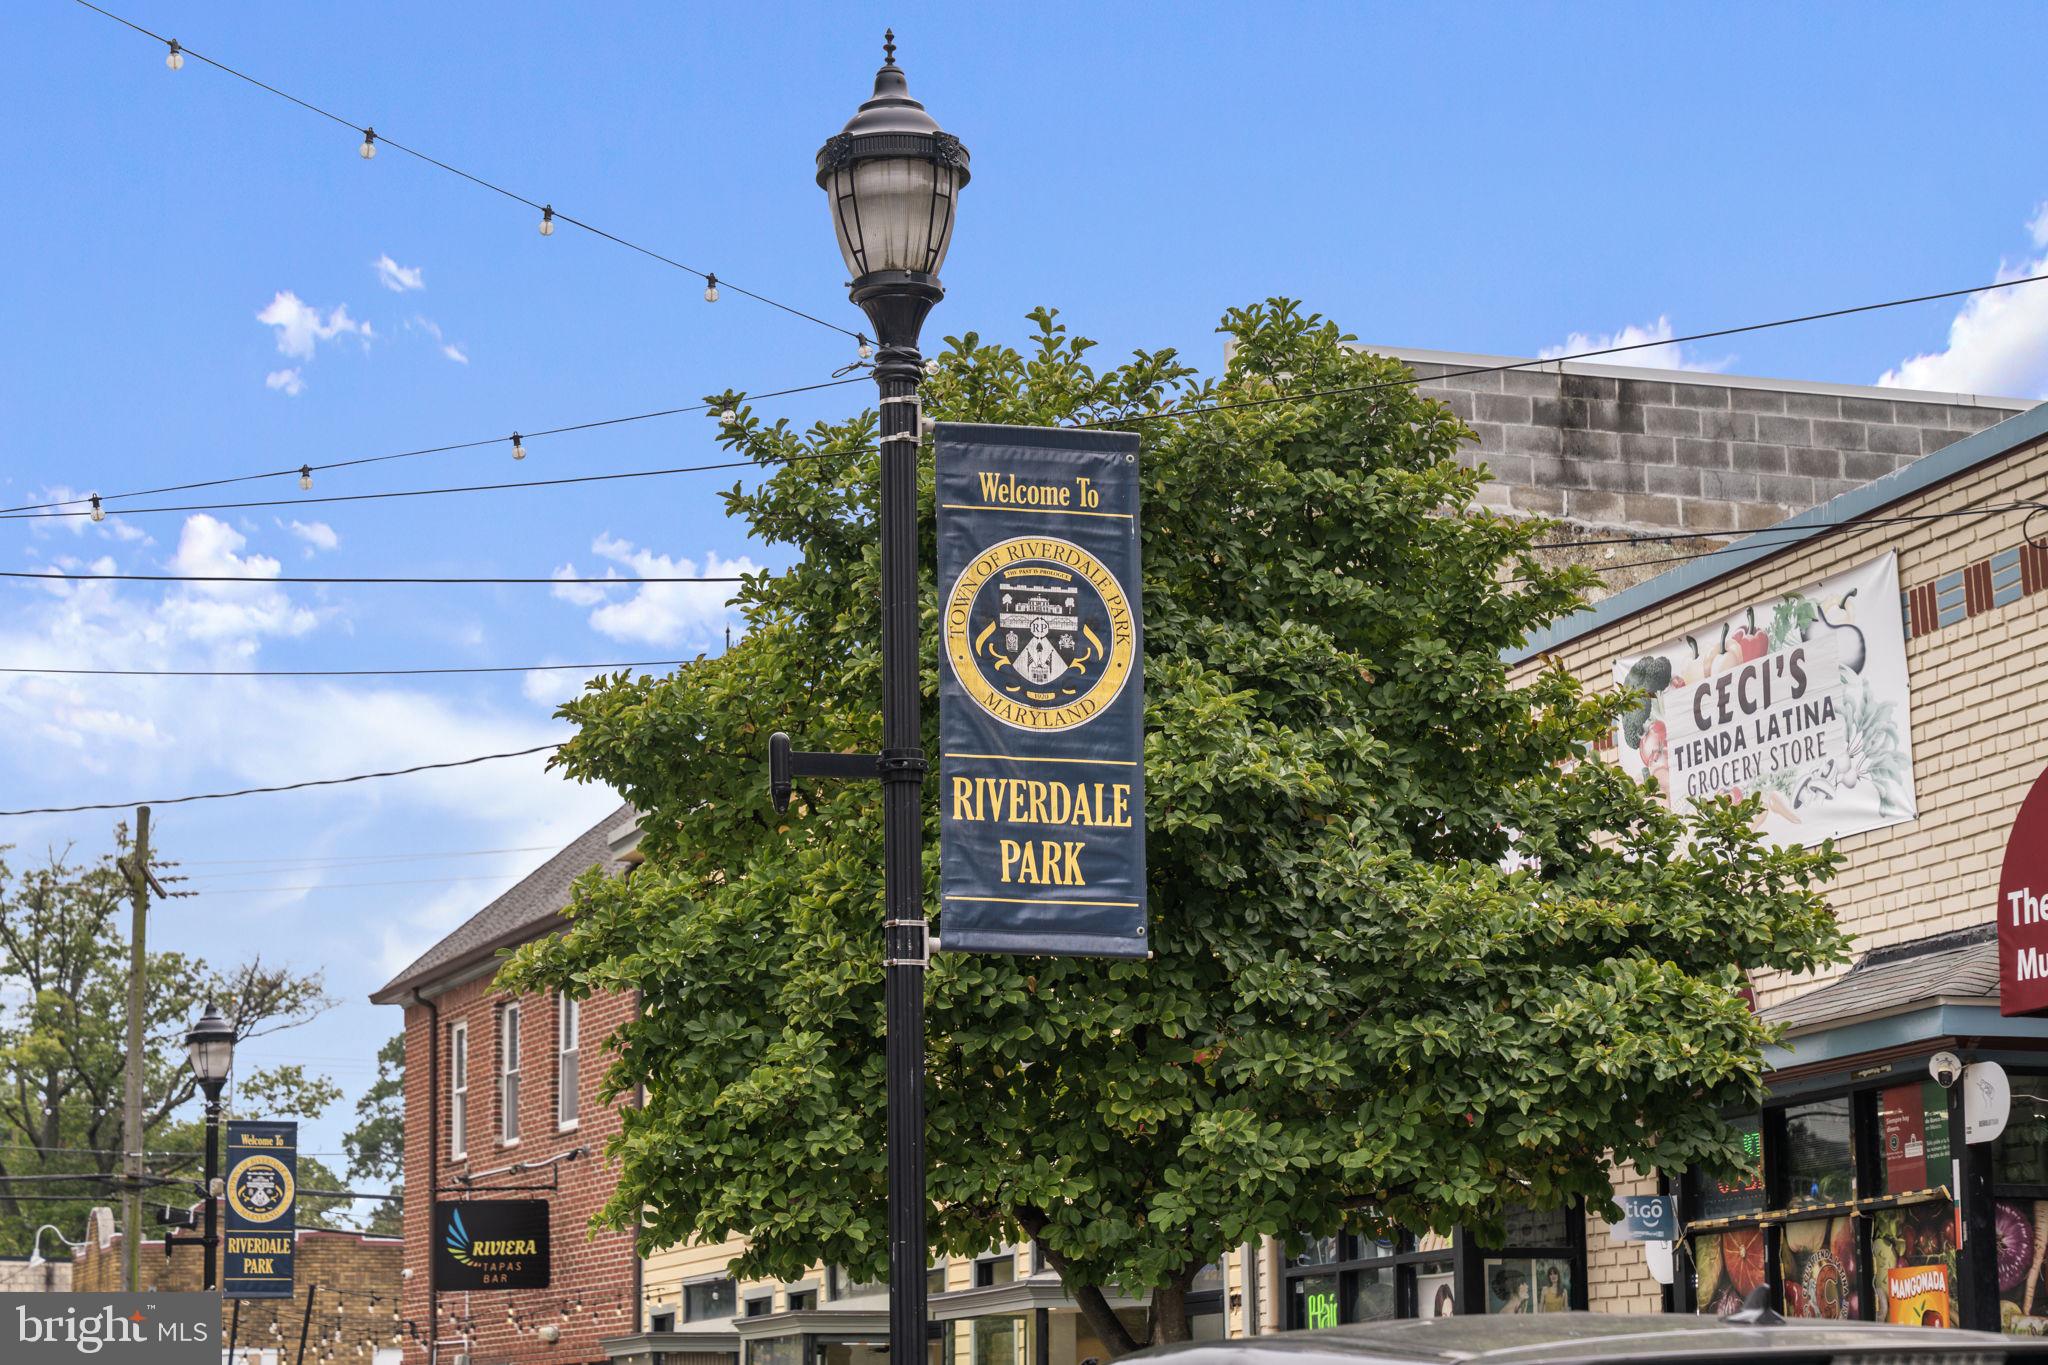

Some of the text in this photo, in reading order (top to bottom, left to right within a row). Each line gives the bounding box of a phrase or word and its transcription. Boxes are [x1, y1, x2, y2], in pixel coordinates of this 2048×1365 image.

[978, 471, 1099, 509] Welcome To
[1039, 569, 1069, 580] PROLOGUE
[950, 542, 1131, 645] TOWN OF RIVERDALE PARK
[1032, 623, 1047, 634] RP
[1693, 648, 1807, 731] CECI'S
[983, 692, 1097, 727] MARYLAND
[1674, 695, 1836, 771] TIENDA LATINA
[1687, 731, 1827, 797] GROCERY STORE
[952, 776, 1132, 828] RIVERDALE
[1000, 839, 1086, 886] PARK
[2007, 887, 2048, 927] The
[241, 1133, 284, 1146] Welcome To
[228, 1237, 291, 1254] RIVERDALE
[472, 1239, 537, 1256] RIVIERA
[243, 1258, 274, 1274] PARK
[483, 1261, 522, 1272] TAPAS
[483, 1274, 508, 1284] BAR
[1890, 1271, 1946, 1299] MANGONADA
